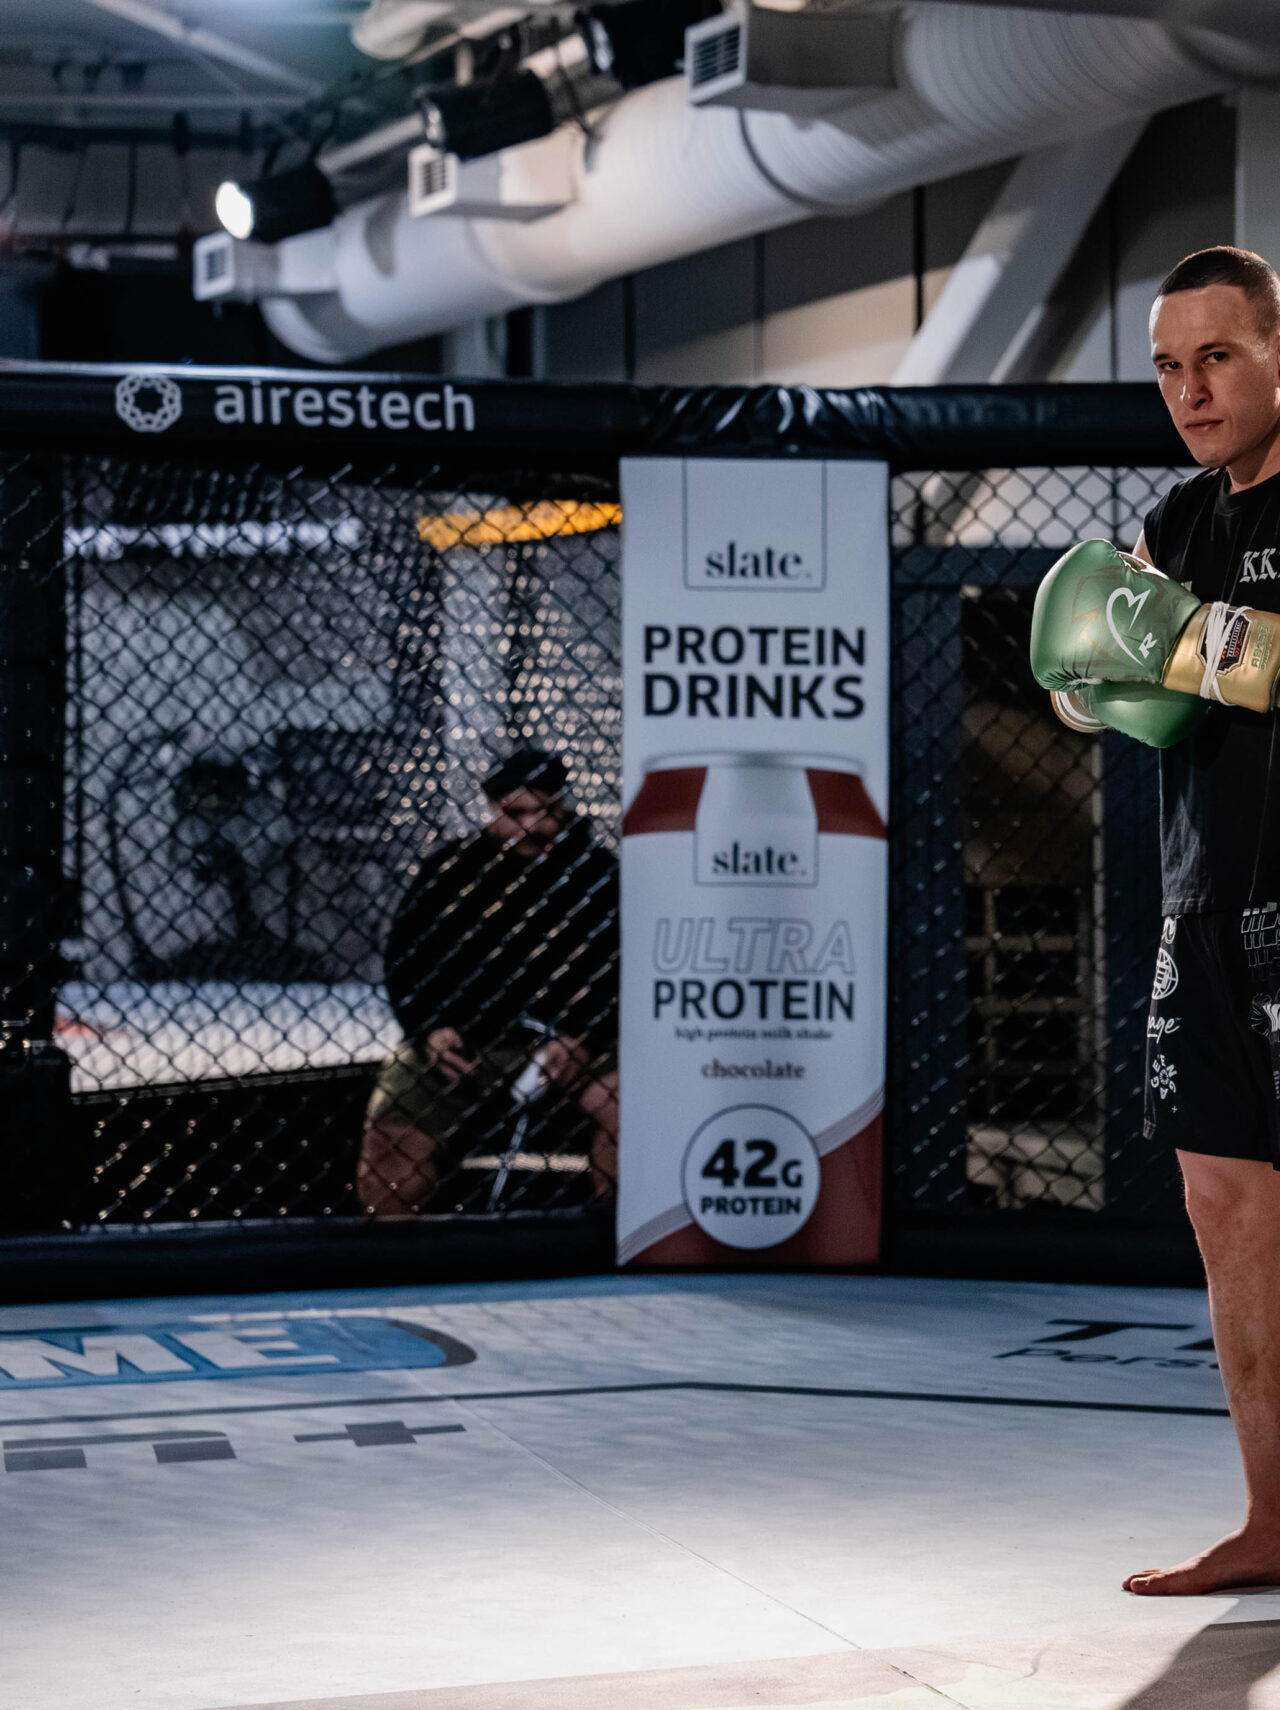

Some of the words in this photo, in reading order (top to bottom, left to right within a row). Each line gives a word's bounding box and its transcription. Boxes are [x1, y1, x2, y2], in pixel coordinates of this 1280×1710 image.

[214, 379, 475, 432] airestech
[643, 625, 866, 667] PROTEIN
[643, 673, 865, 720] DRINKS
[652, 916, 857, 976] ULTRA
[653, 978, 855, 1022] PROTEIN
[701, 1058, 805, 1080] chocolate
[701, 1138, 804, 1189] 42G
[701, 1196, 801, 1216] PROTEIN
